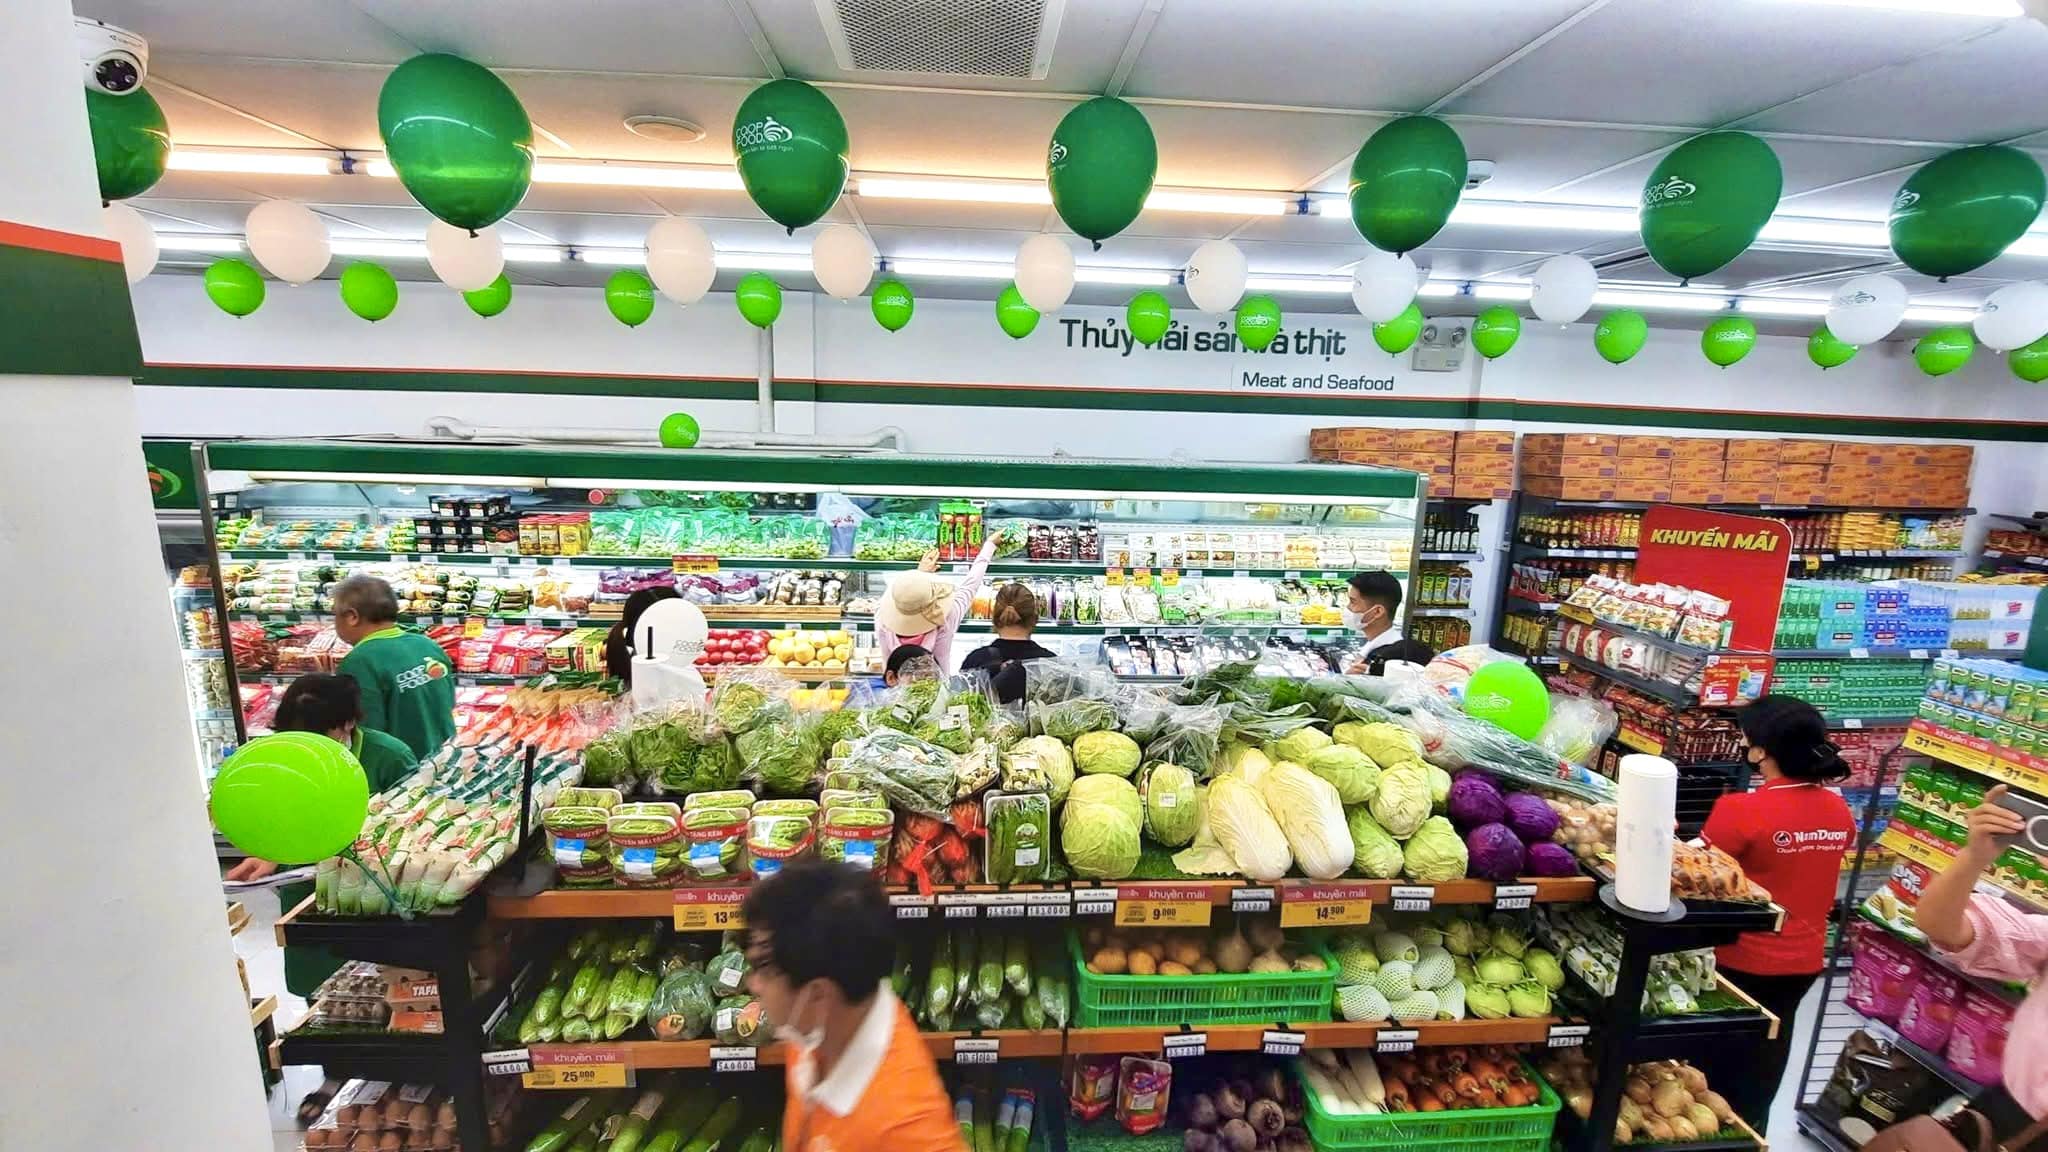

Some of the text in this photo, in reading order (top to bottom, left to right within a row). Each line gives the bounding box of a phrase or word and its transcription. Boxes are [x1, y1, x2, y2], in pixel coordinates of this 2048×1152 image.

[736, 121, 764, 138] COOP
[736, 132, 764, 150] FOOD
[1059, 318, 1135, 357] Thủy
[1293, 327, 1347, 362] thịt
[1242, 371, 1395, 391] Meat and Seafood
[1650, 526, 1780, 552] KHUYẾN MÃI
[396, 664, 426, 684] COOP
[399, 673, 431, 694] FOOD
[412, 984, 438, 997] TAFA
